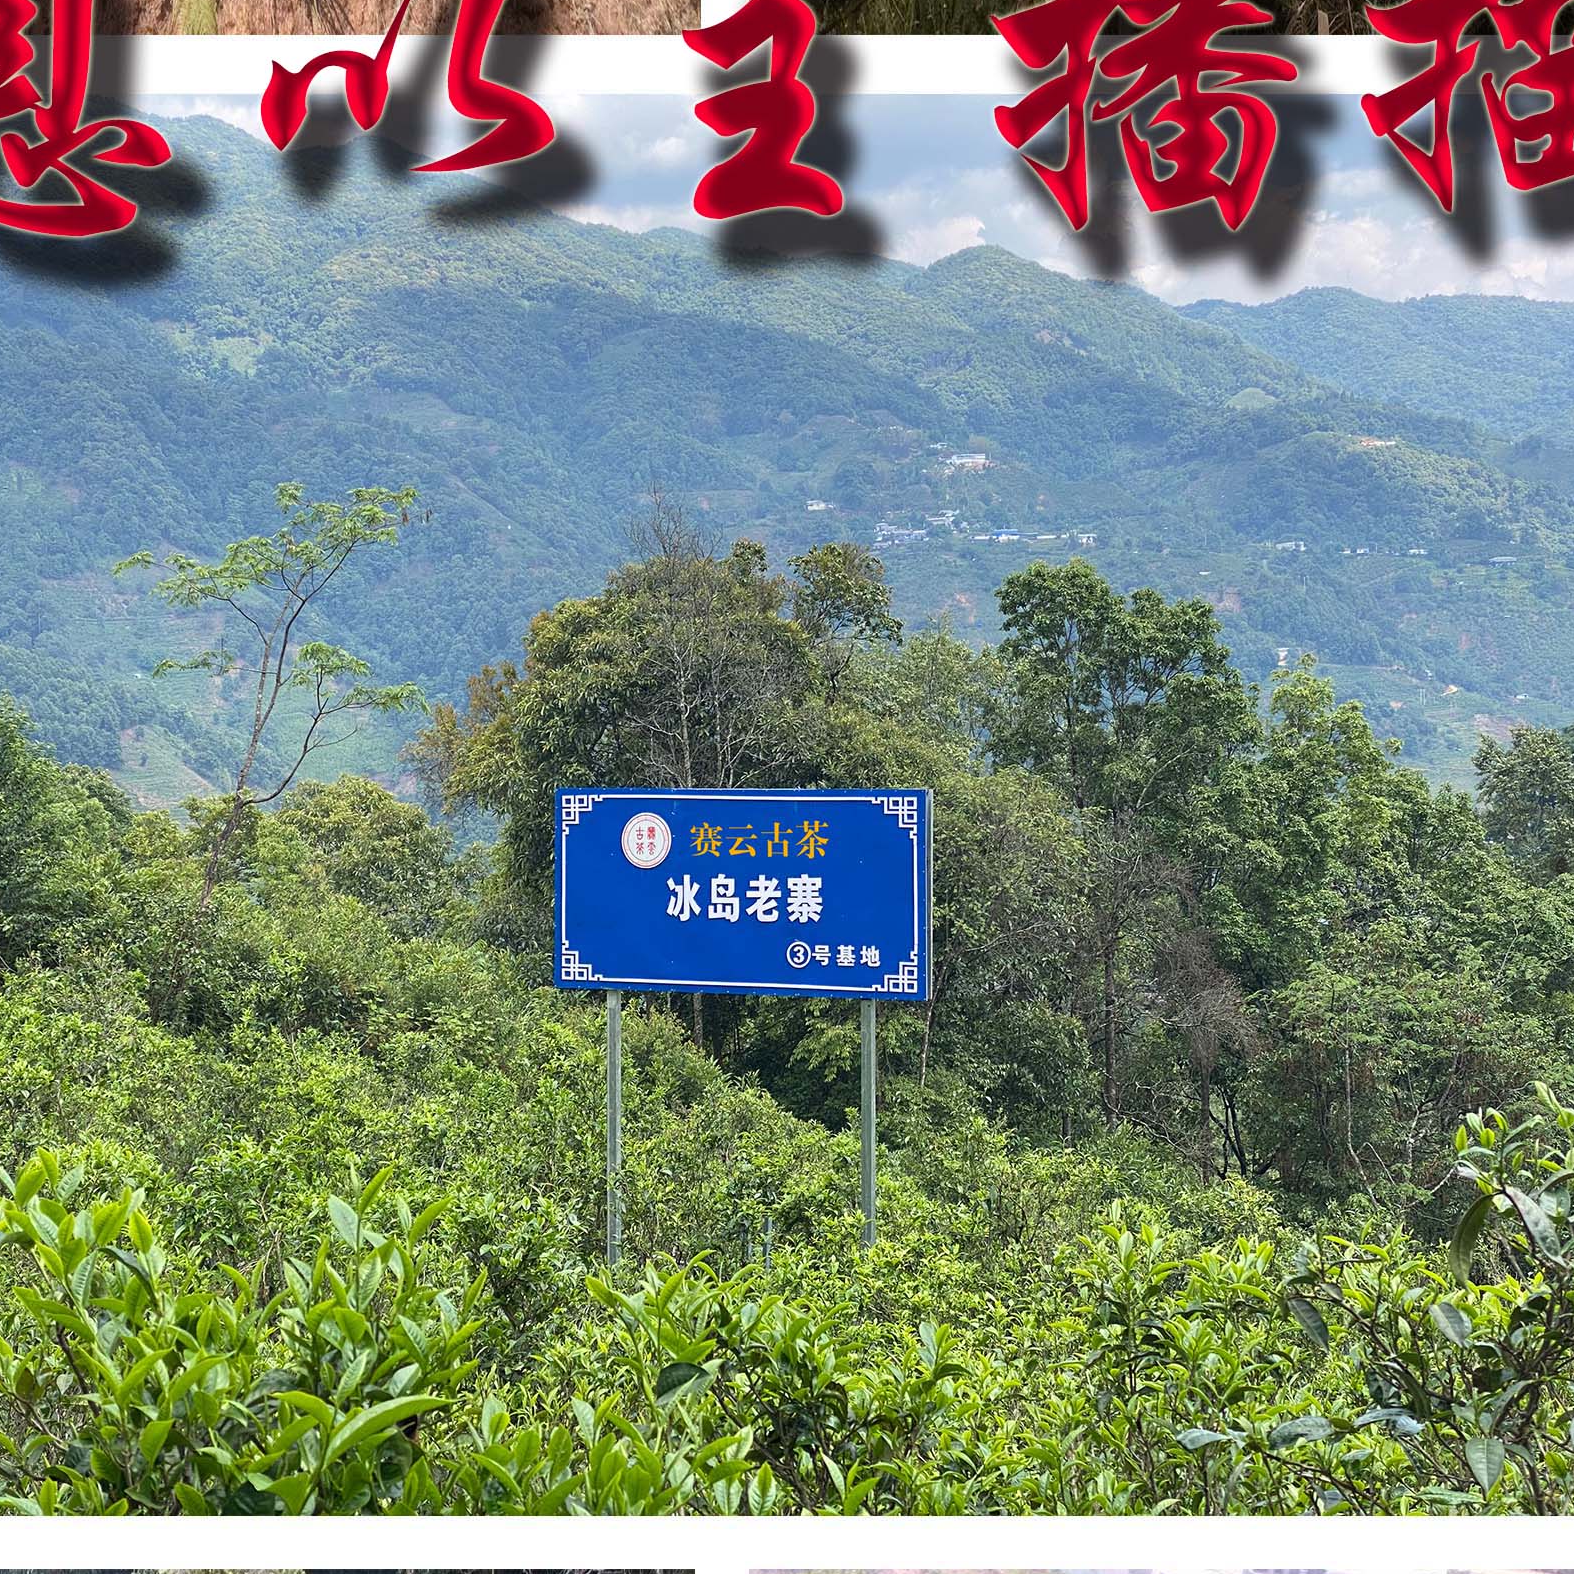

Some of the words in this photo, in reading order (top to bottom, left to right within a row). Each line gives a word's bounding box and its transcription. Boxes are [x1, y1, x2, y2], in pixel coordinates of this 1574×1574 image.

[689, 821, 829, 859] 赛云古茶
[666, 874, 824, 923] 冰岛老寨
